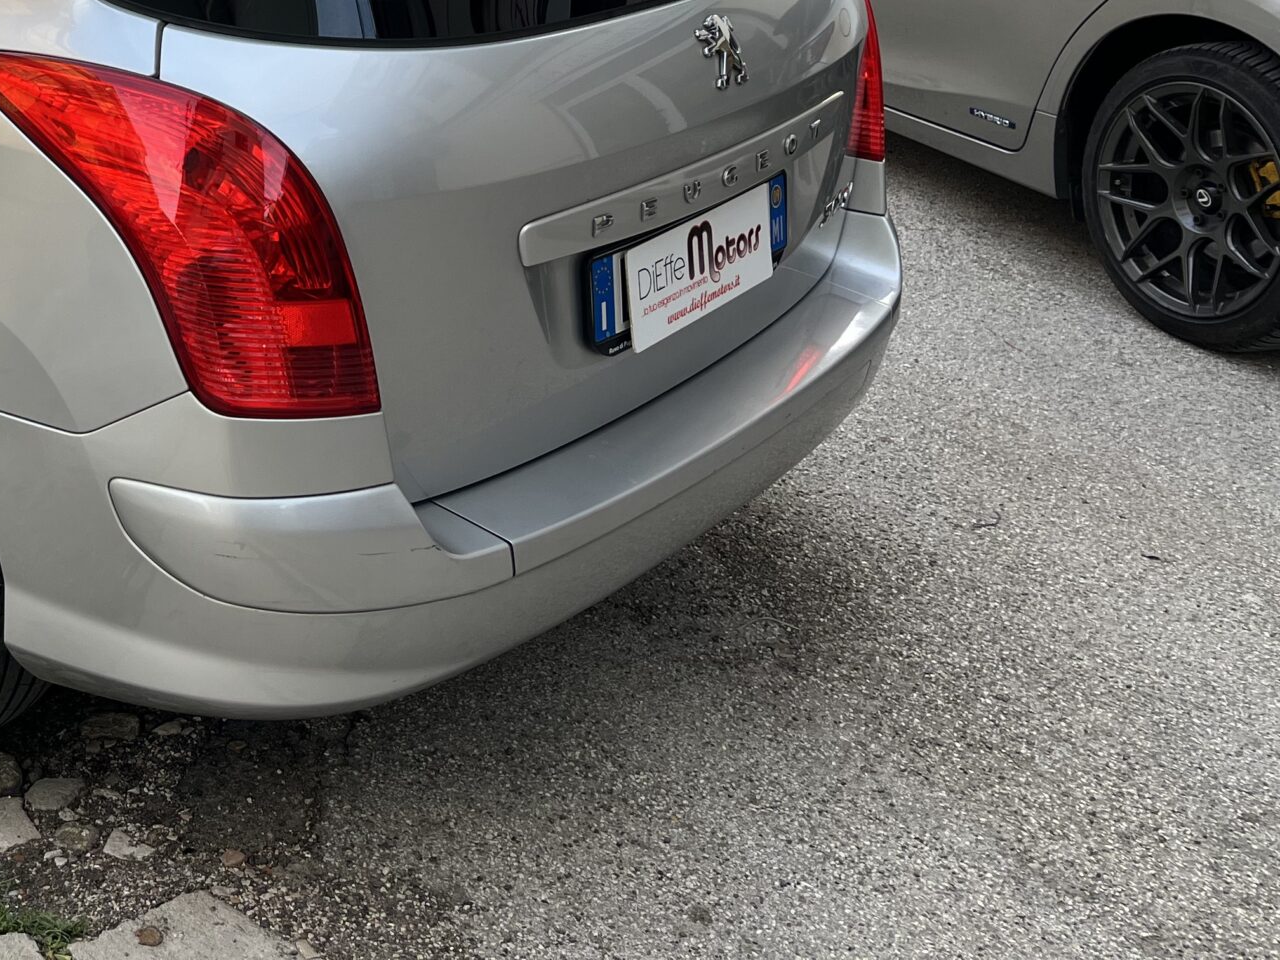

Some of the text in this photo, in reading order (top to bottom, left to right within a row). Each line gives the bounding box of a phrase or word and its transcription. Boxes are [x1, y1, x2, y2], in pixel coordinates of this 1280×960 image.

[591, 119, 823, 238] PEUGEOT
[637, 219, 762, 301] DiEffe Motors
[771, 215, 784, 243] MI
[666, 274, 741, 325] www.dieffemotors.it
